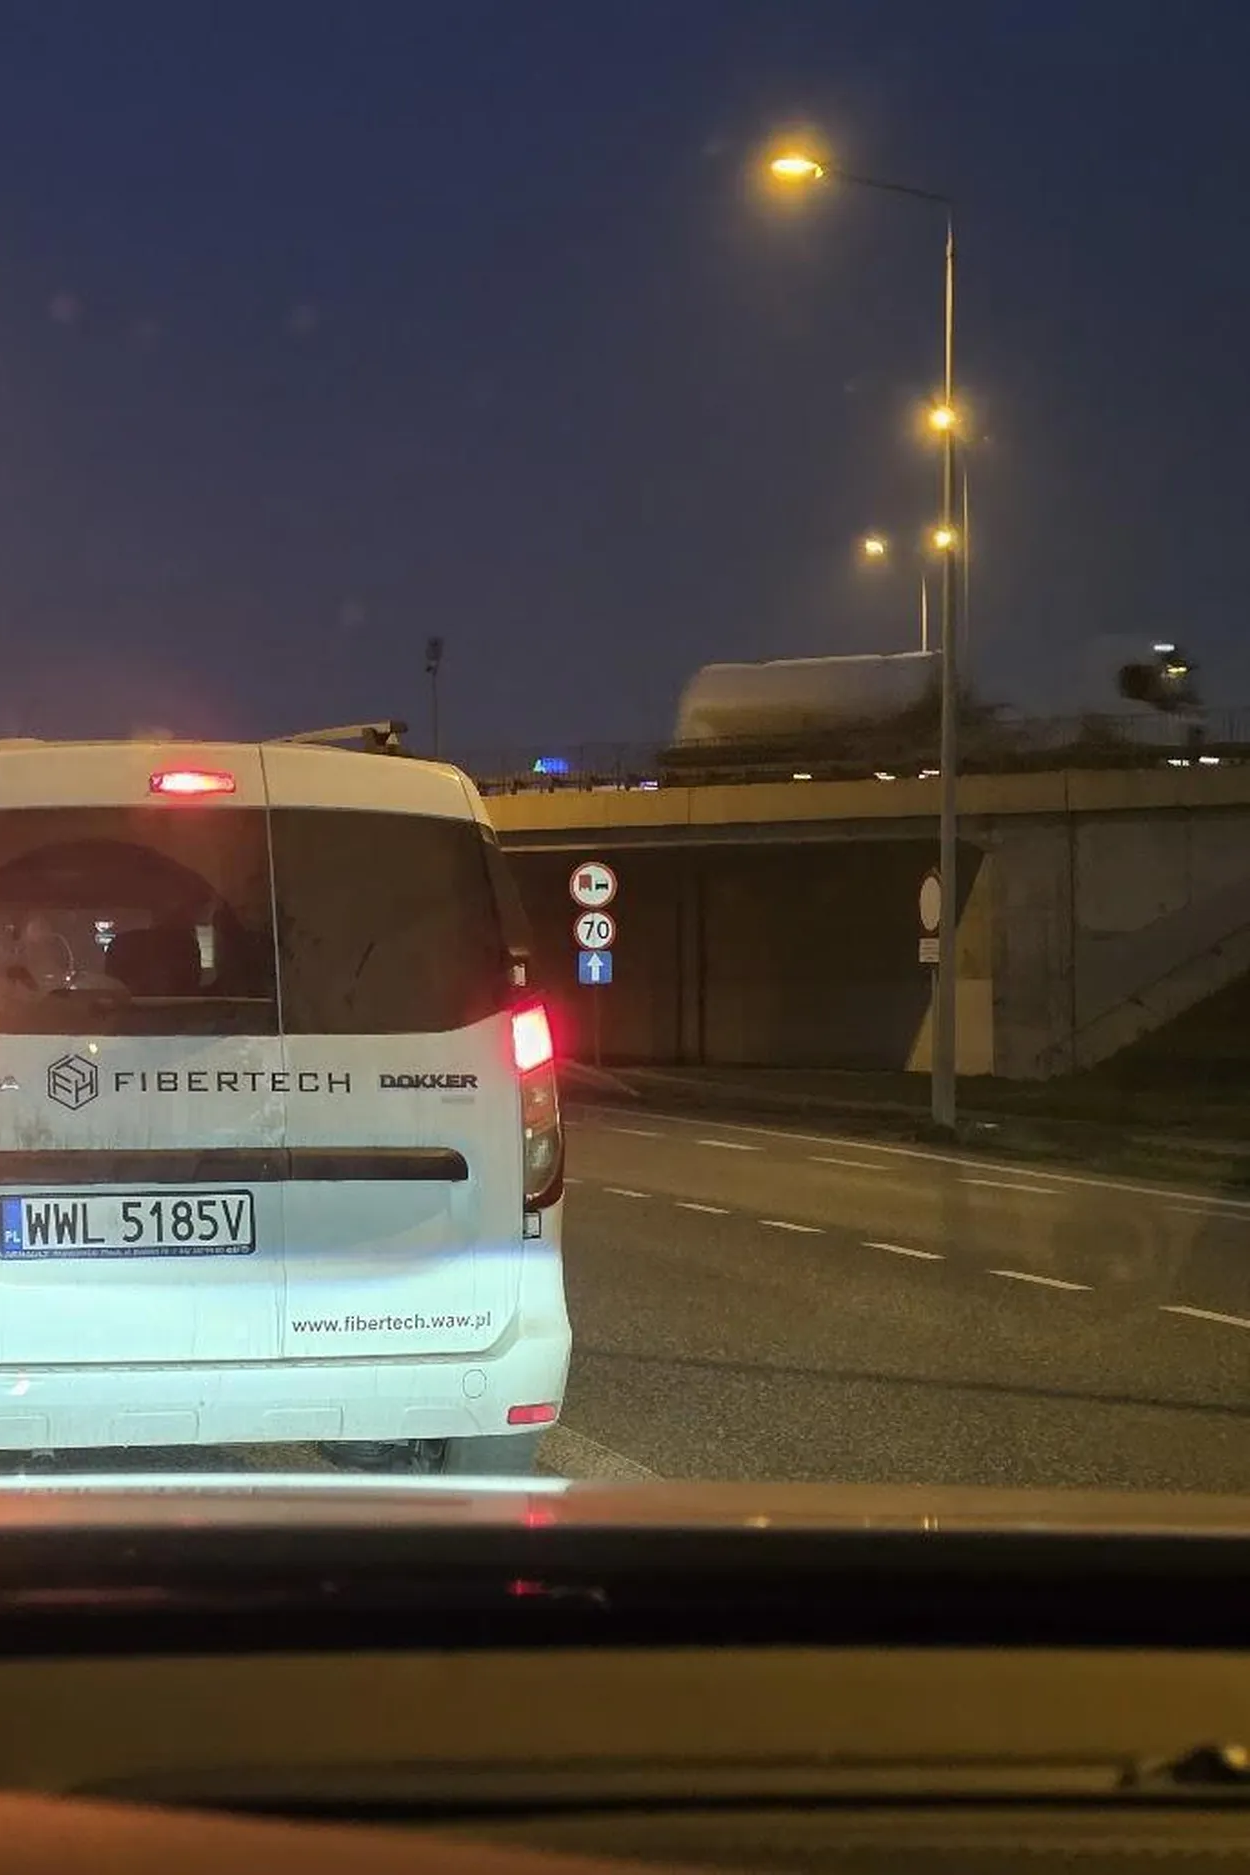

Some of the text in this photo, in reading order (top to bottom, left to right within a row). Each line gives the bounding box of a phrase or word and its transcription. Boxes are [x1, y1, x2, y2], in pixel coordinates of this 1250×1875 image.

[583, 921, 610, 940] 70
[114, 1071, 351, 1093] FIBERTECH
[379, 1073, 478, 1088] DOKKER
[25, 1199, 245, 1245] WWL 5185V
[5, 1230, 21, 1243] PL
[291, 1311, 492, 1332] www.fibertech.waw.pl
